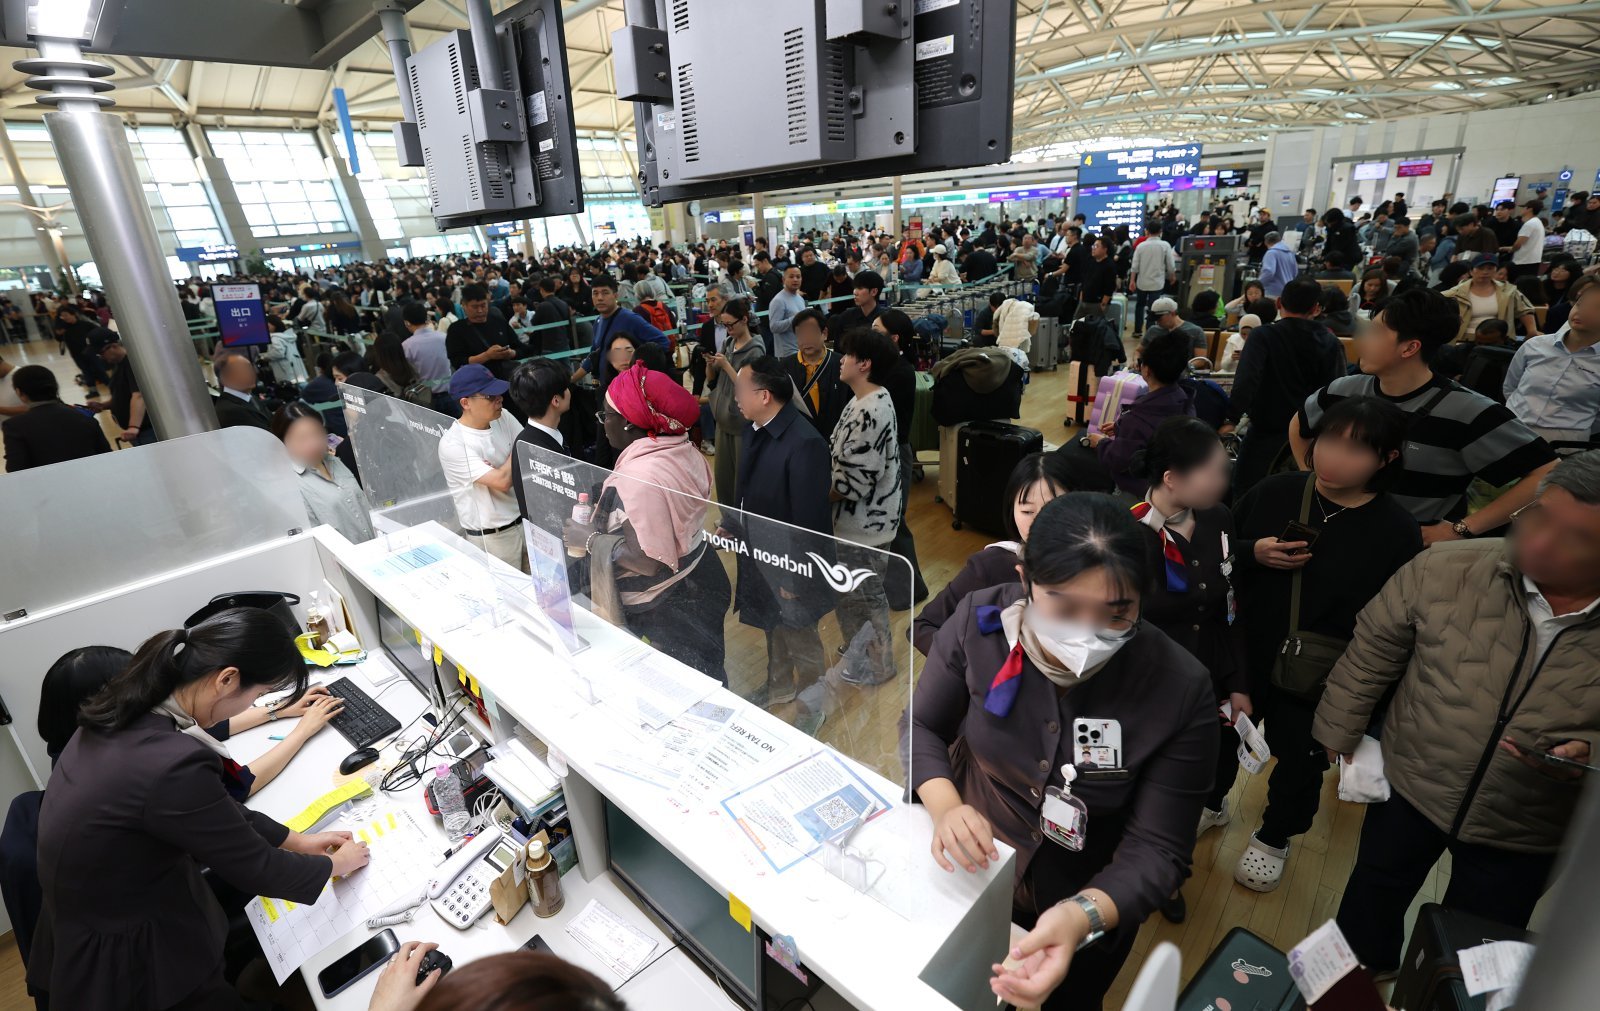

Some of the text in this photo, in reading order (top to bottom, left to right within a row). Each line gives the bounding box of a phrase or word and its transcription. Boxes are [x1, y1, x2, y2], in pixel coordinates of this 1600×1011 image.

[1084, 155, 1092, 166] 4
[230, 308, 251, 316] 出口
[746, 732, 761, 745] TAX
[761, 742, 776, 753] NO
